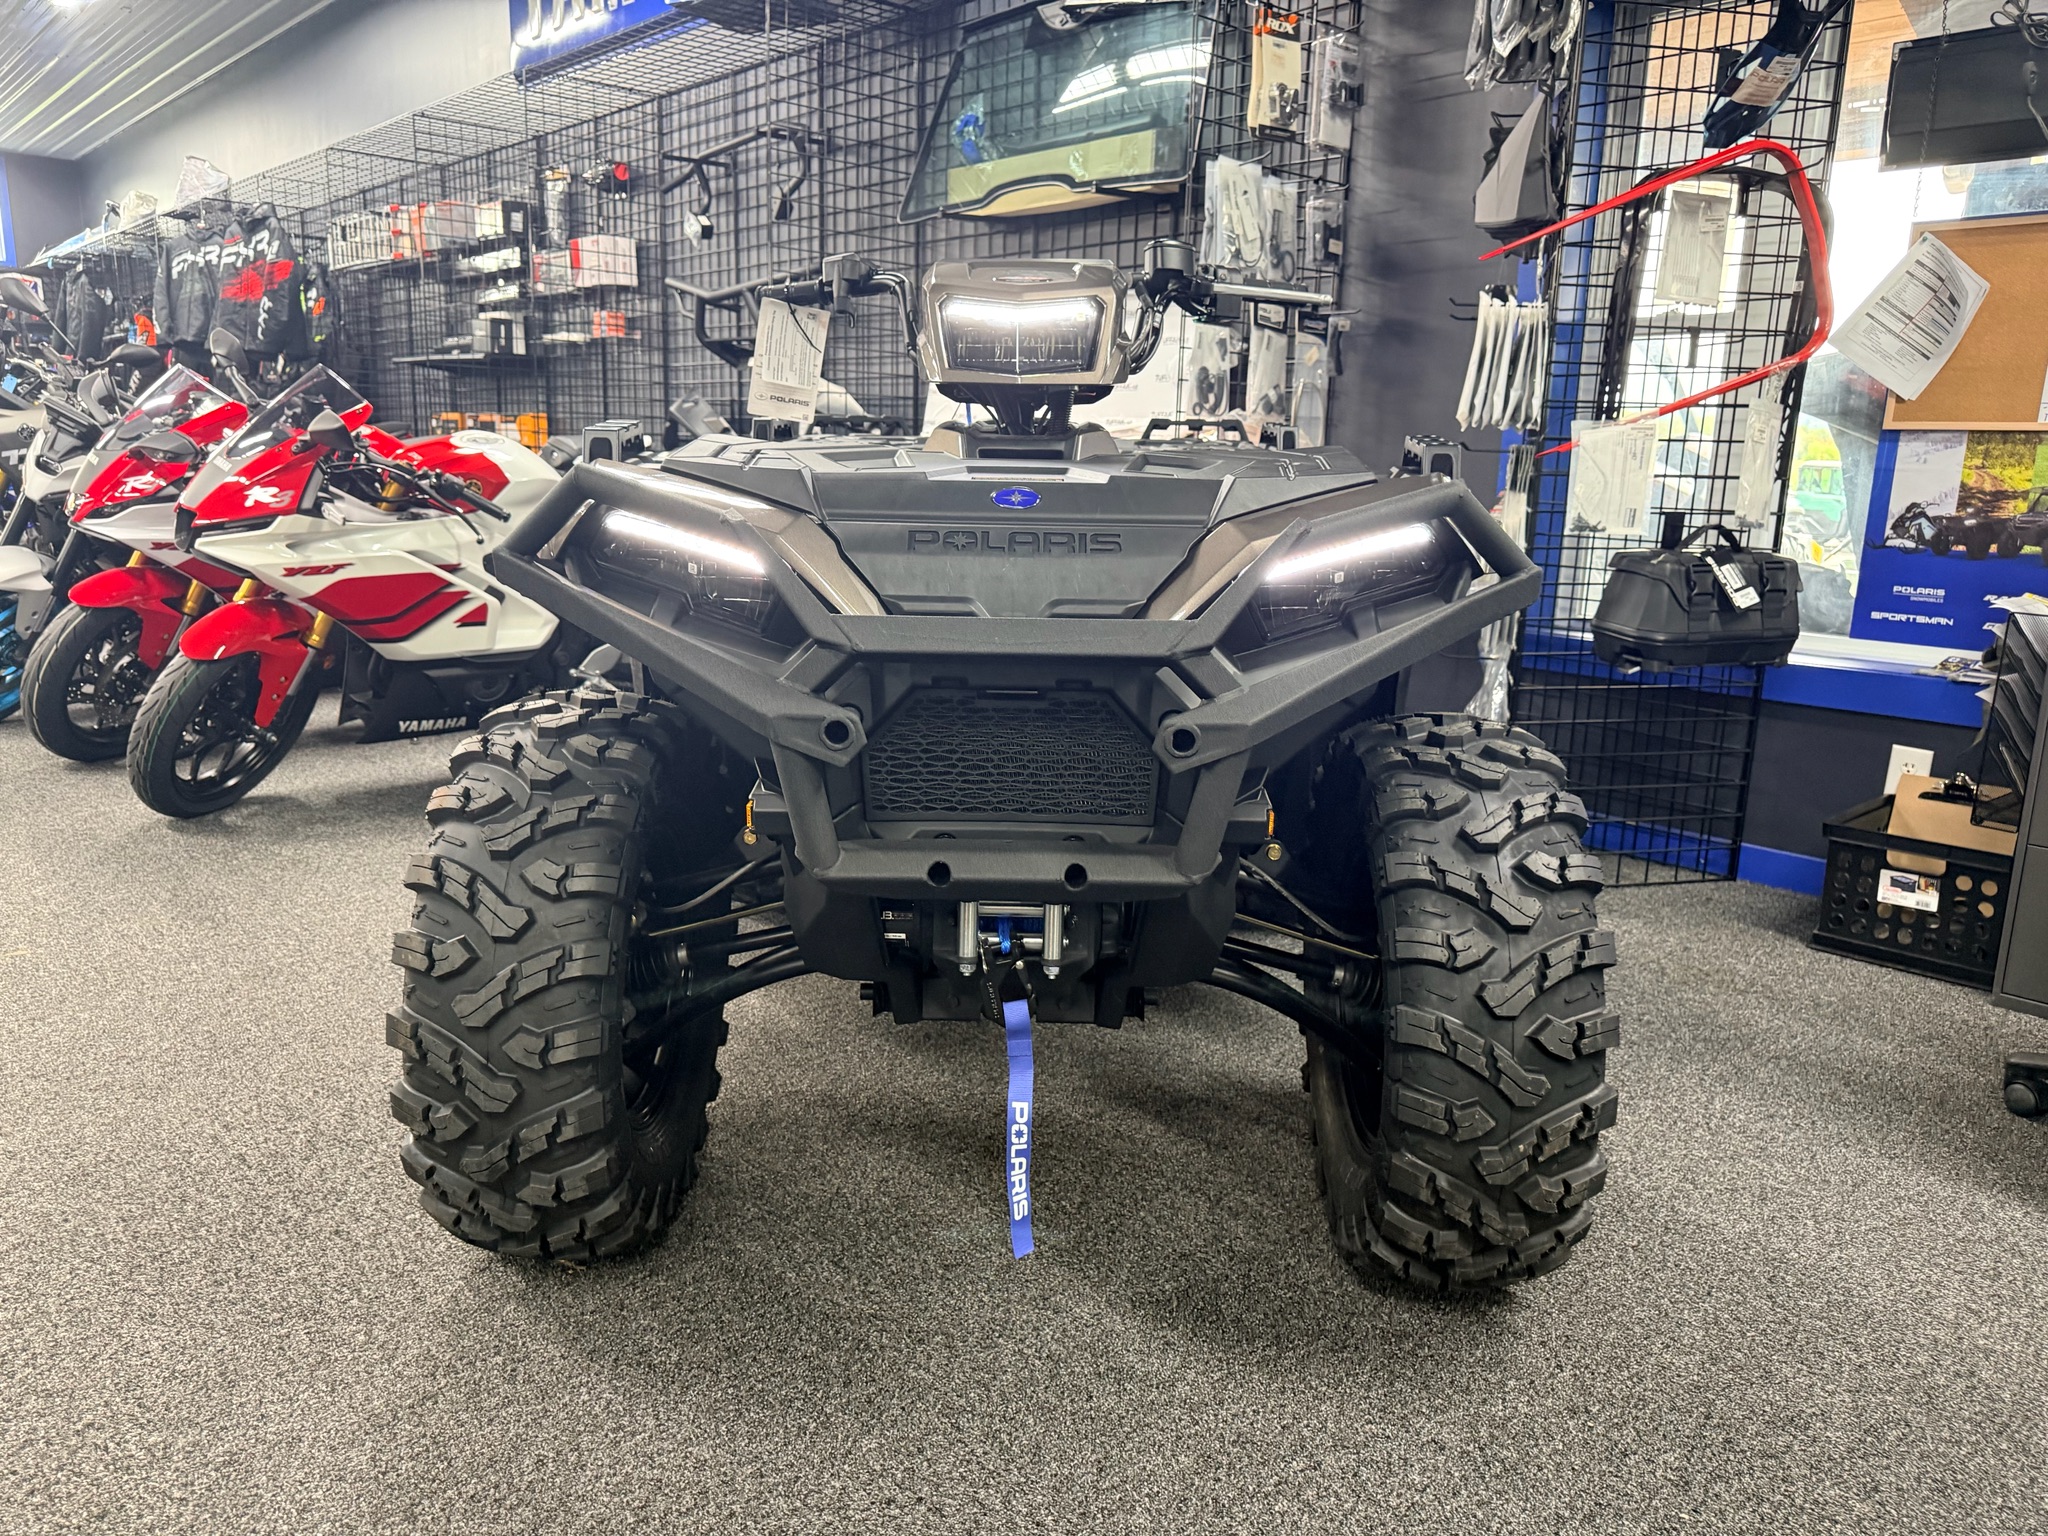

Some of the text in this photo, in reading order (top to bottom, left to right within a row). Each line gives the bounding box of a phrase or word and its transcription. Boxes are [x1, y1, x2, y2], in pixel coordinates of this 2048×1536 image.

[769, 394, 811, 407] POLARIS
[243, 485, 295, 508] R3
[906, 529, 1122, 553] POLARIS
[1892, 585, 1946, 596] POLARIS
[1870, 611, 1954, 626] SPORTSMAN
[399, 716, 467, 733] YAMAHA
[1010, 1101, 1030, 1221] POLARIS
